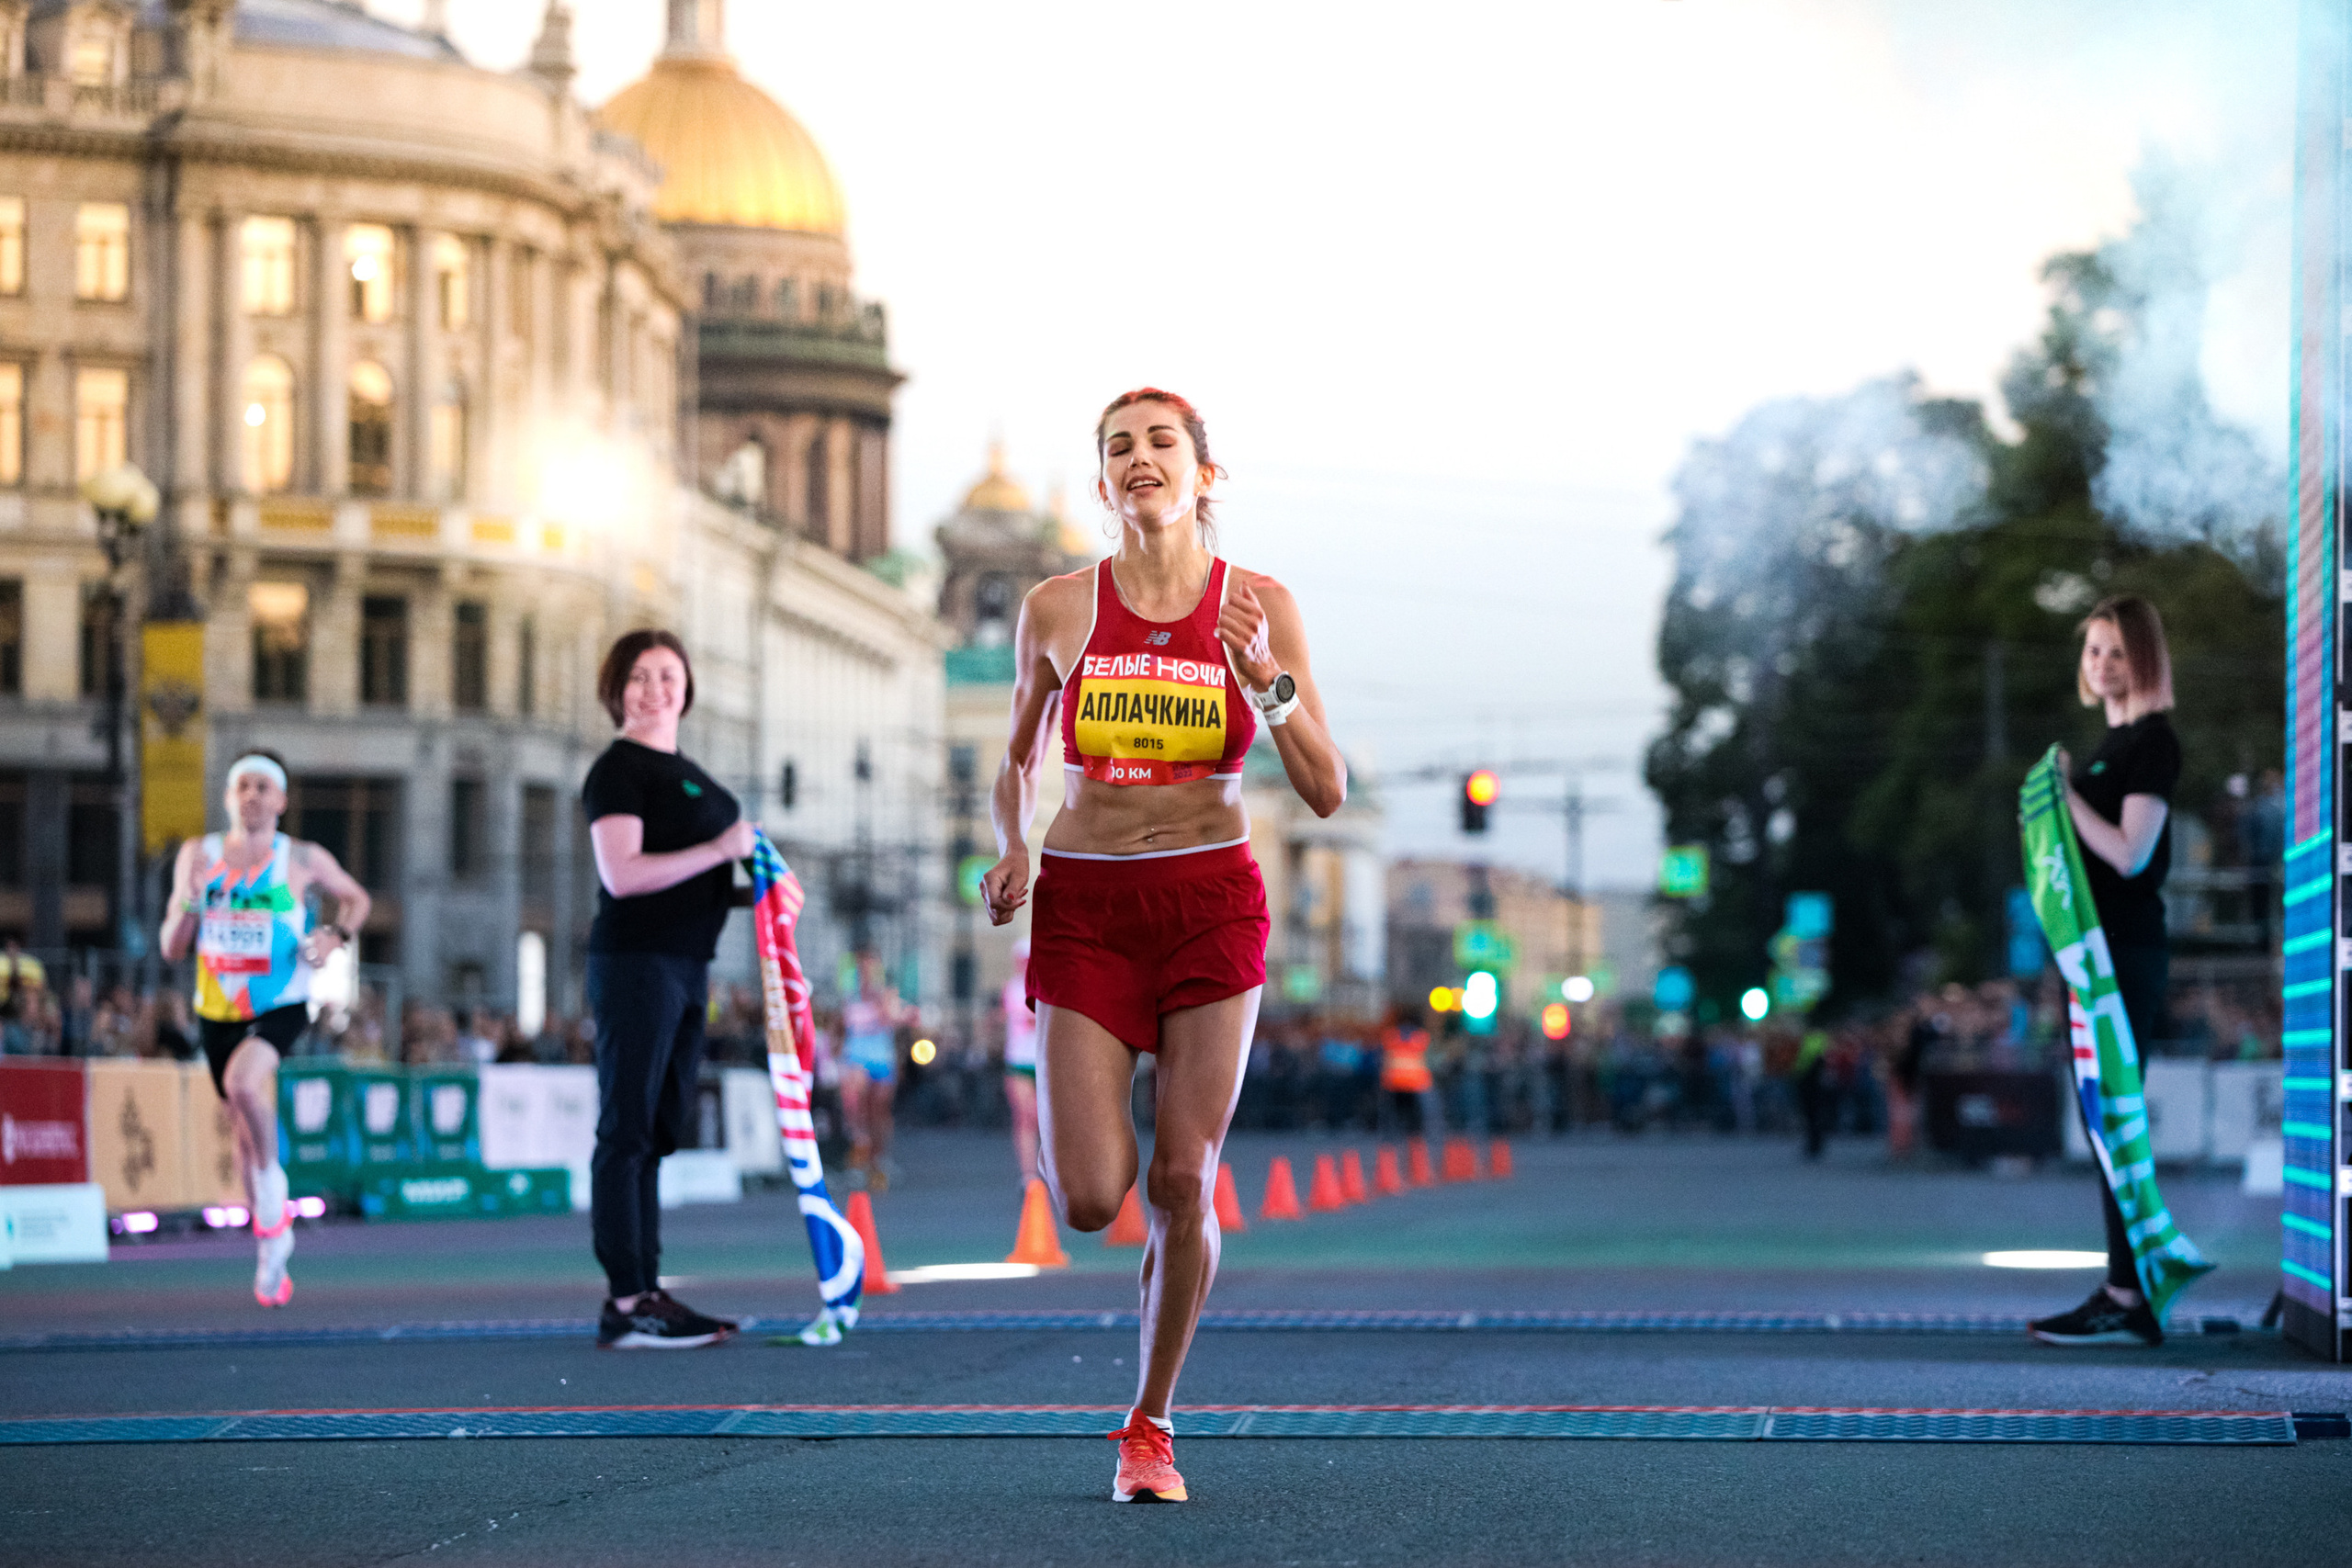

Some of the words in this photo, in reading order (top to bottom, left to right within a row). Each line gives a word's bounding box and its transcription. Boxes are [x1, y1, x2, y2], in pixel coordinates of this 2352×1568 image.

[1081, 653, 1151, 676] БЕЛЫЕ
[1157, 656, 1227, 687] НОЧИ
[1080, 692, 1221, 728] АПЛАЧКИНА
[1133, 737, 1164, 750] 8015
